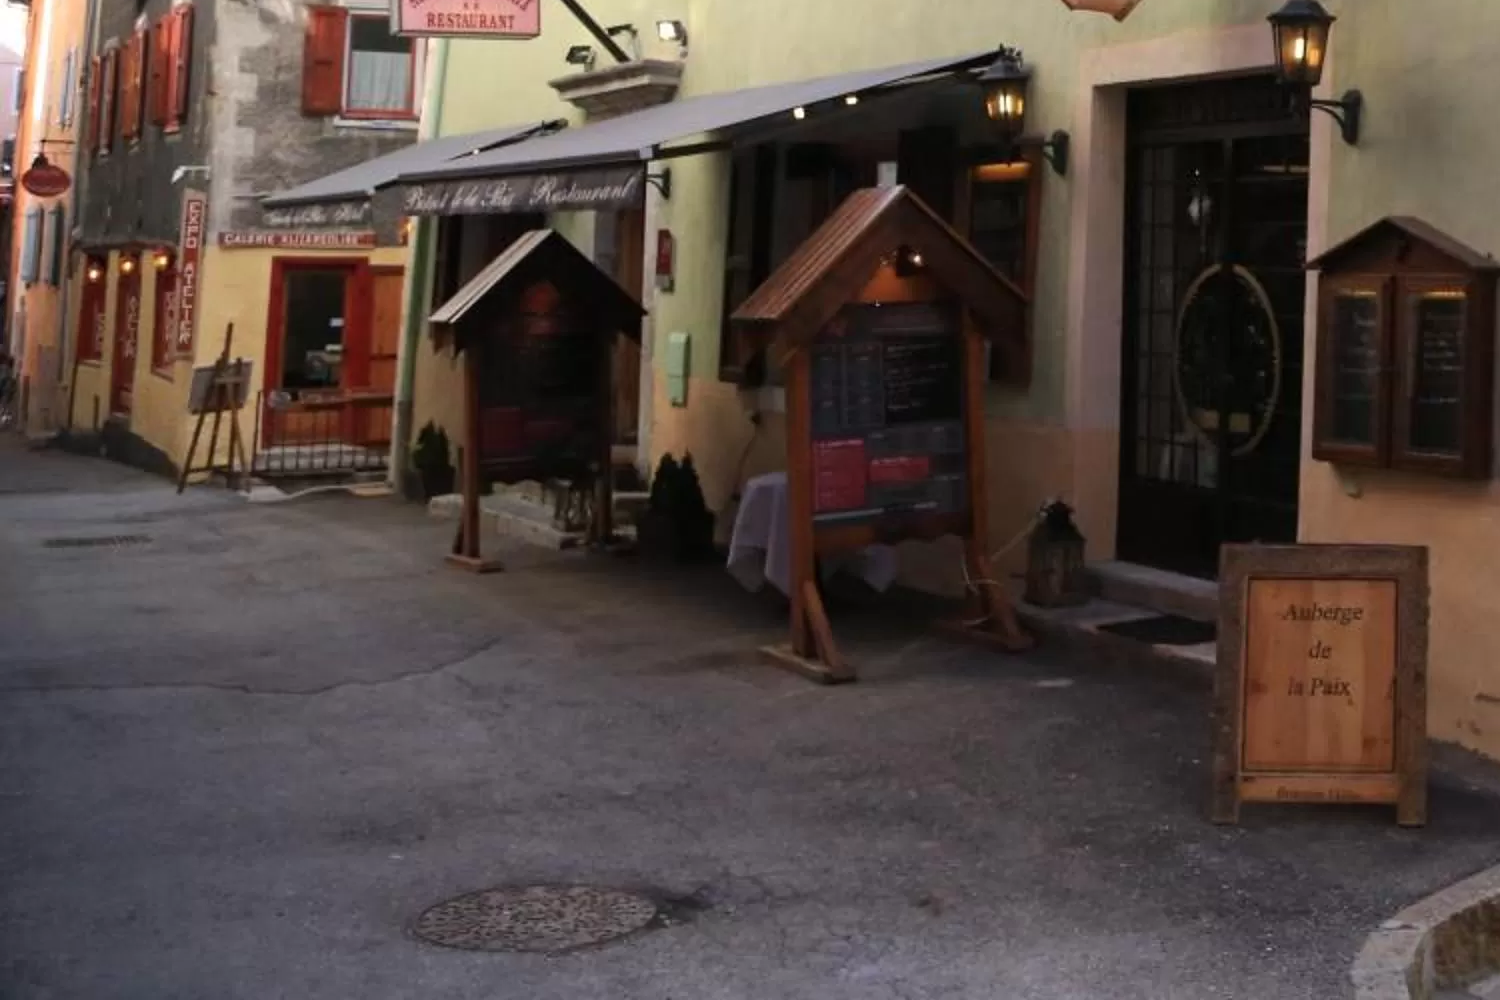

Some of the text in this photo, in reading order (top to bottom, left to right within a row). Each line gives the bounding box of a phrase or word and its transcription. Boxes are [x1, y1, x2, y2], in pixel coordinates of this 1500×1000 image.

[426, 12, 515, 29] RESTAURANT
[530, 173, 636, 205] Restaurant
[178, 201, 201, 345] EXPO ATELIER
[1281, 603, 1364, 625] Auberge
[1308, 640, 1332, 659] de
[1288, 676, 1351, 696] la Paix
